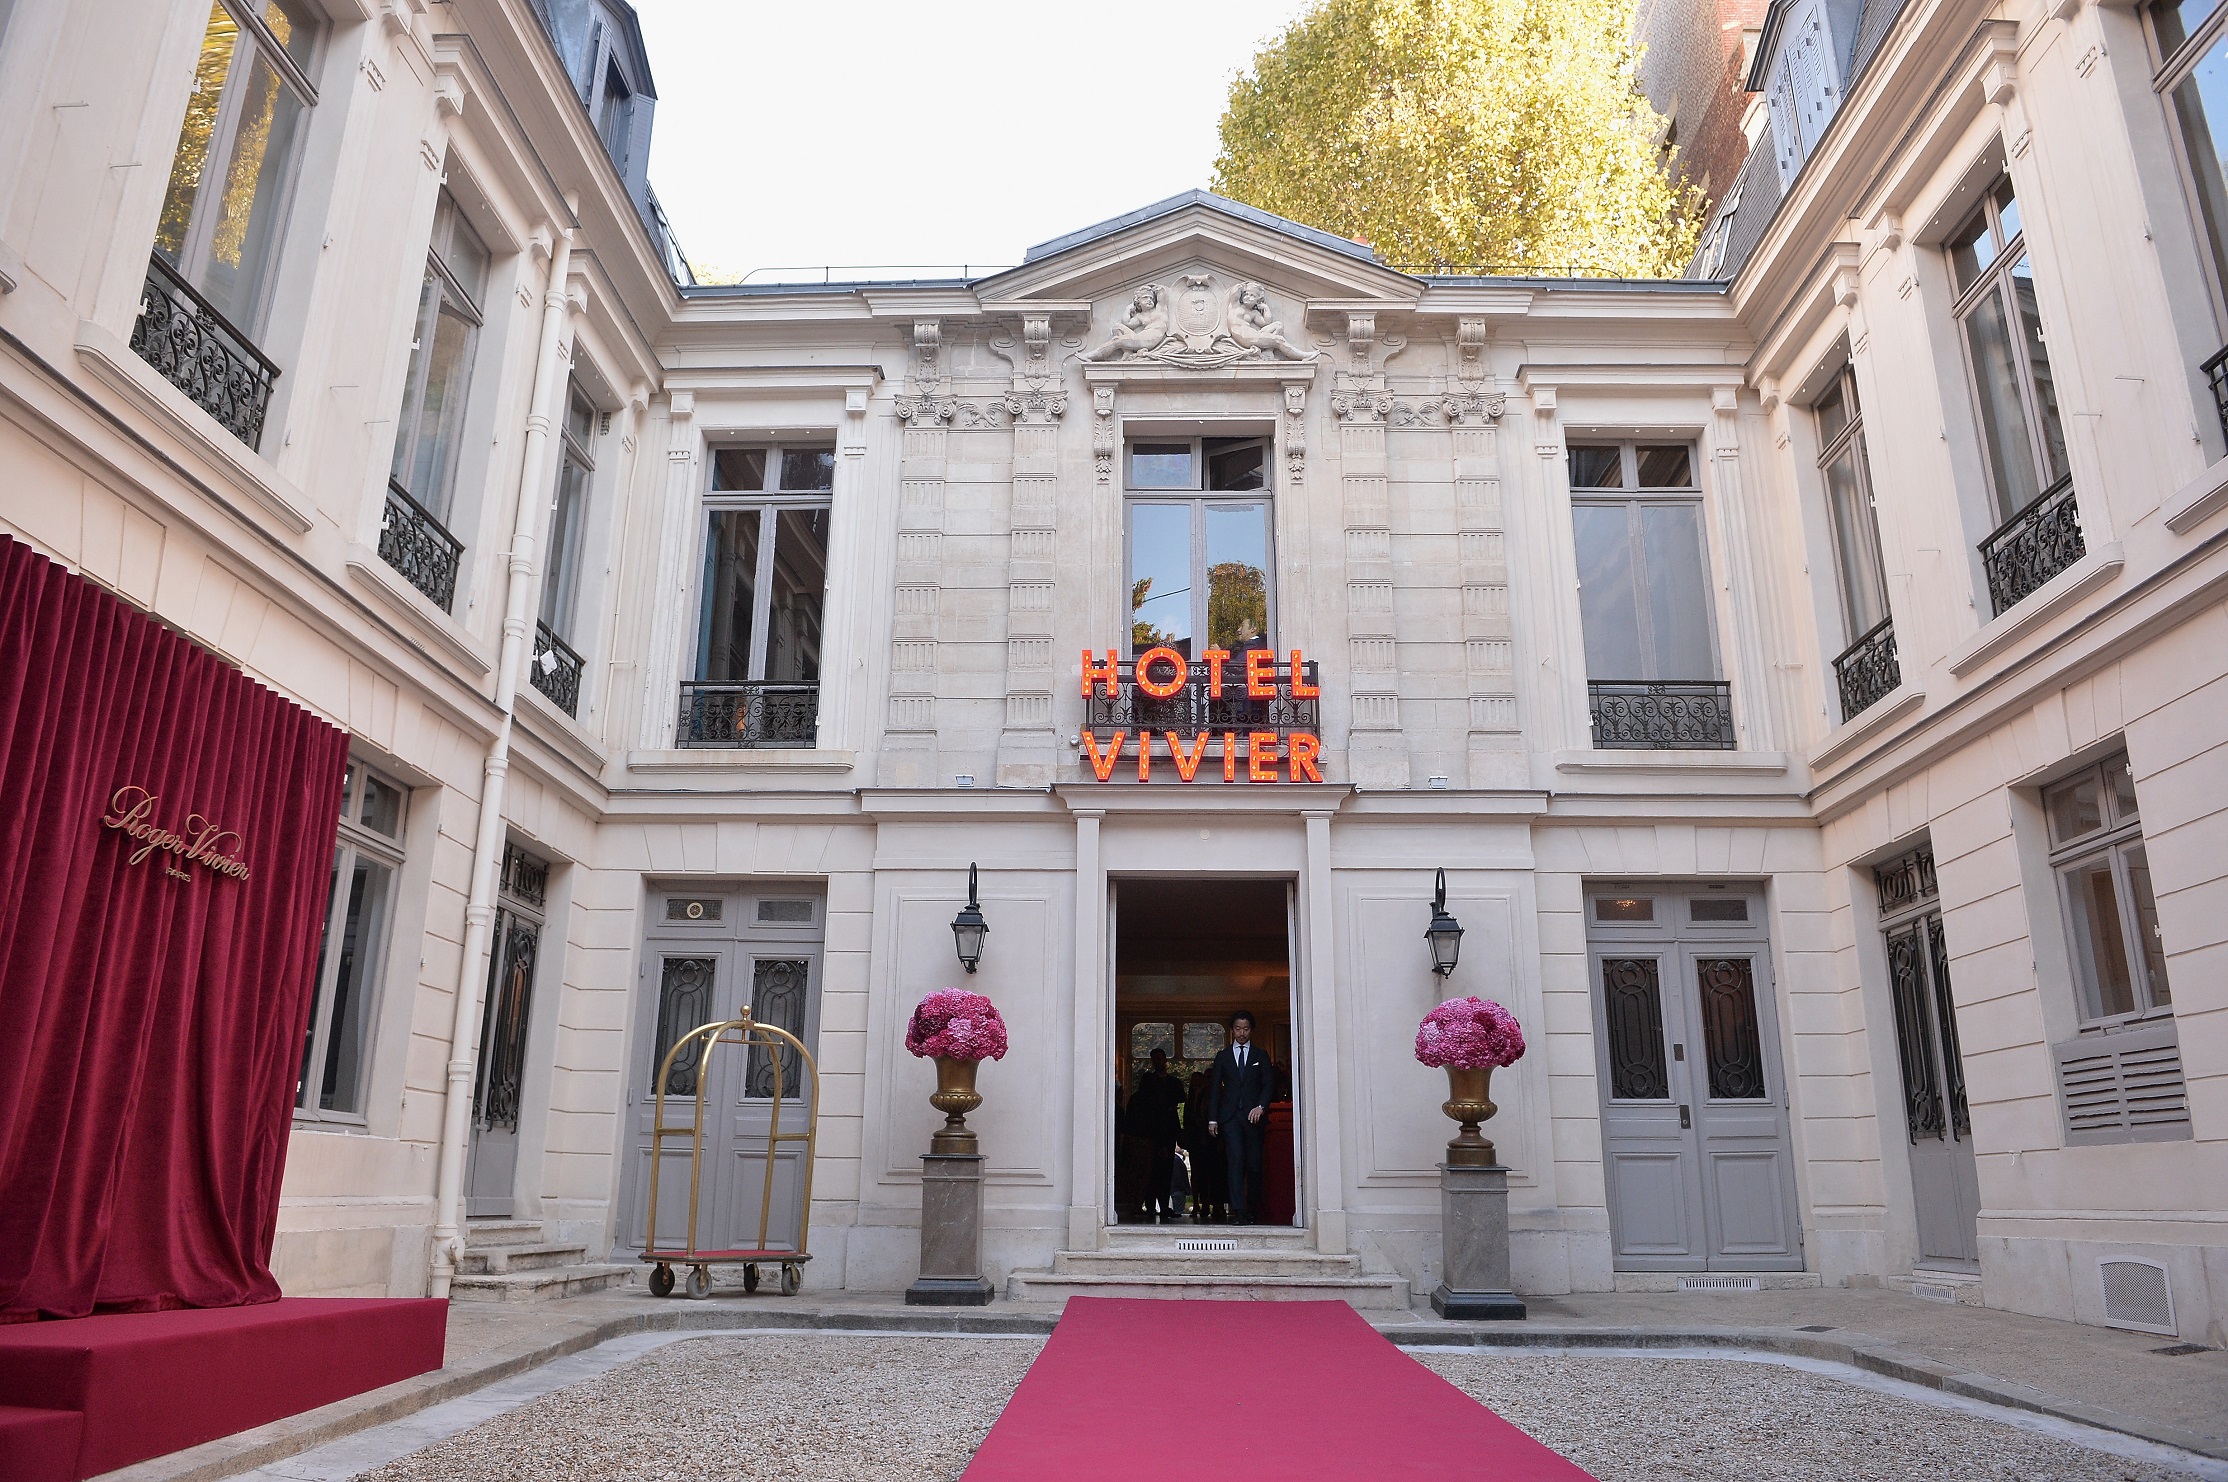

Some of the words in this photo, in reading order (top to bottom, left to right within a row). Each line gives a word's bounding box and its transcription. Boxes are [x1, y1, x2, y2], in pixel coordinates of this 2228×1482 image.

[1081, 647, 1320, 700] HOTEL
[1081, 731, 1323, 783] VIVIER
[103, 785, 185, 866] Roger
[185, 813, 250, 881] Vivier
[165, 867, 192, 883] PARIS
